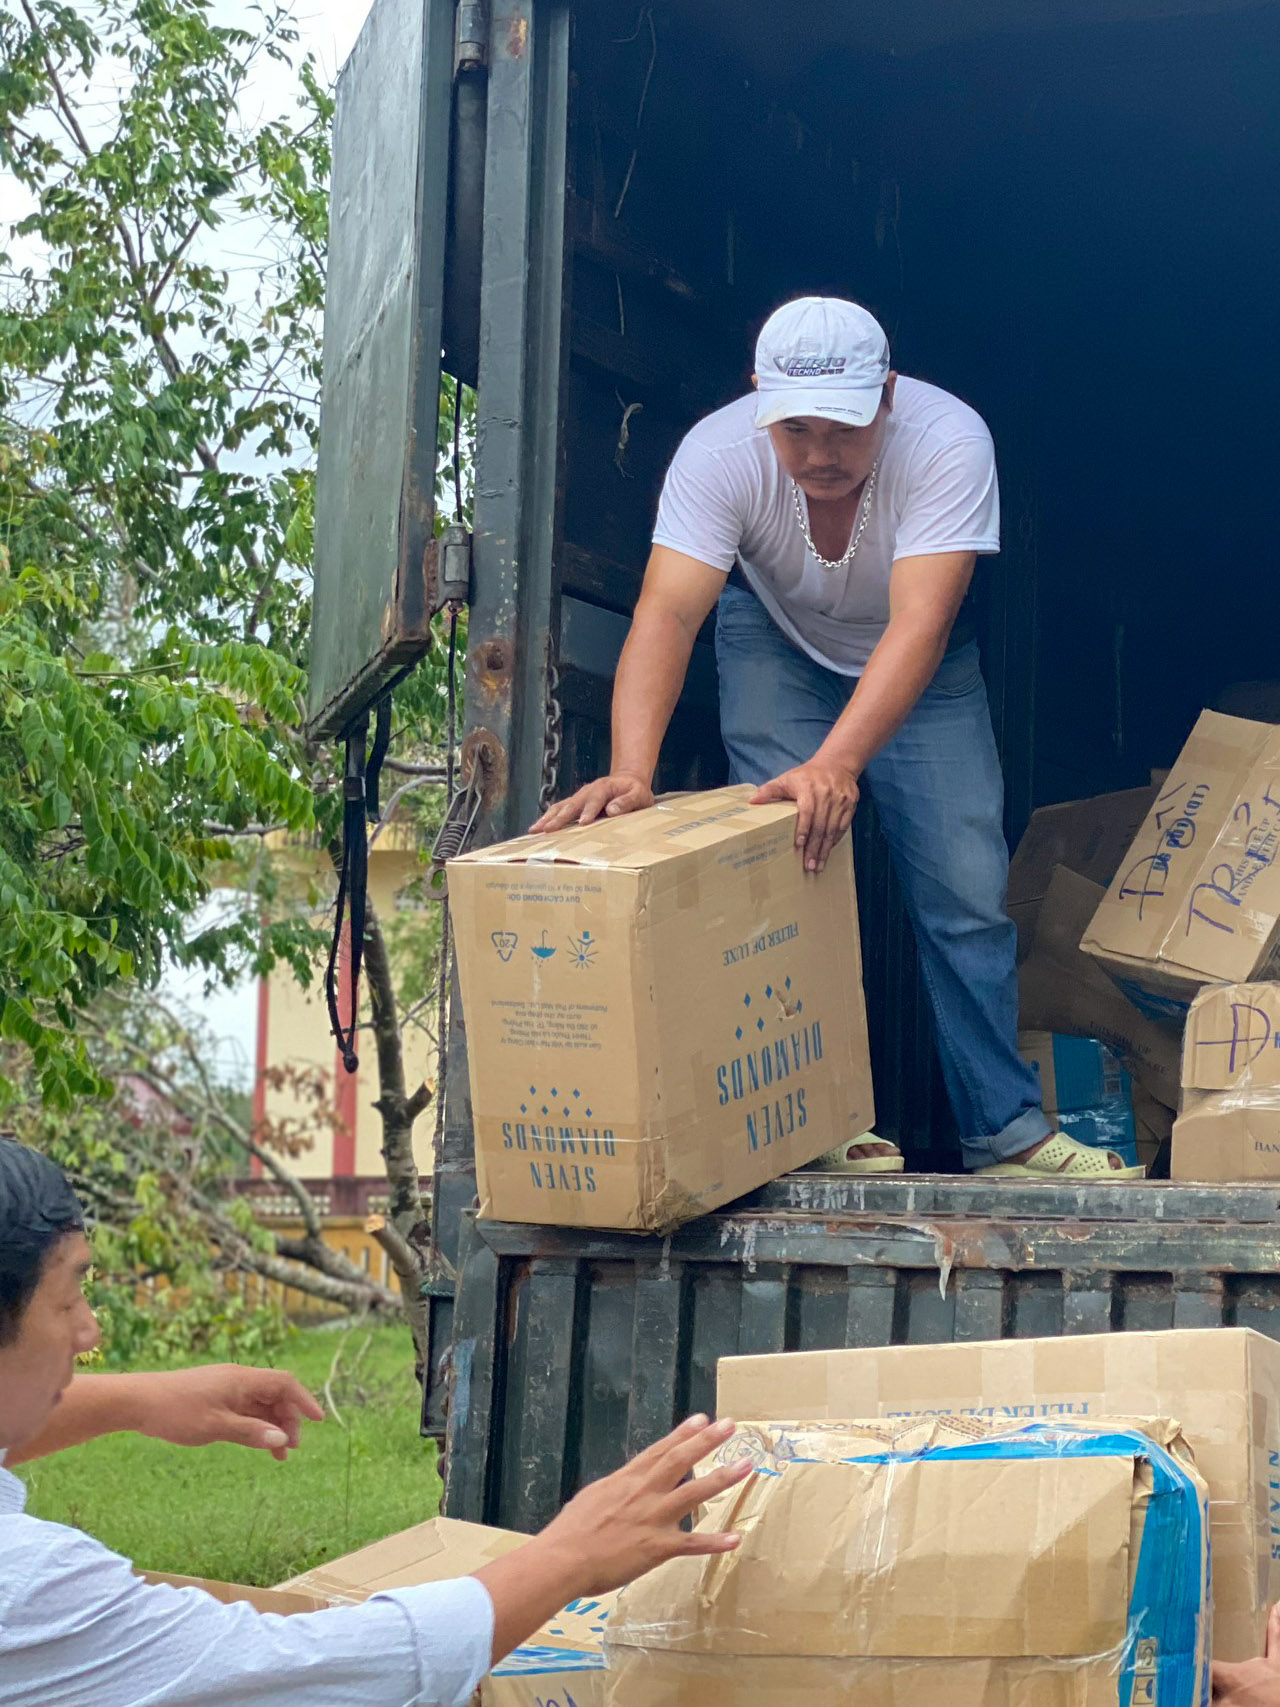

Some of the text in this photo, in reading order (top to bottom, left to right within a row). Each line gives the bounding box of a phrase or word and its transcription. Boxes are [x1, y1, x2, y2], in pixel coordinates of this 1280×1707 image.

[722, 921, 799, 967] FILTER DE LUXE
[717, 1021, 824, 1106] DIAMONDS
[502, 1122, 616, 1158] DIAMONDS
[746, 1087, 808, 1155] SEVEN
[530, 1162, 597, 1193] SEVEN
